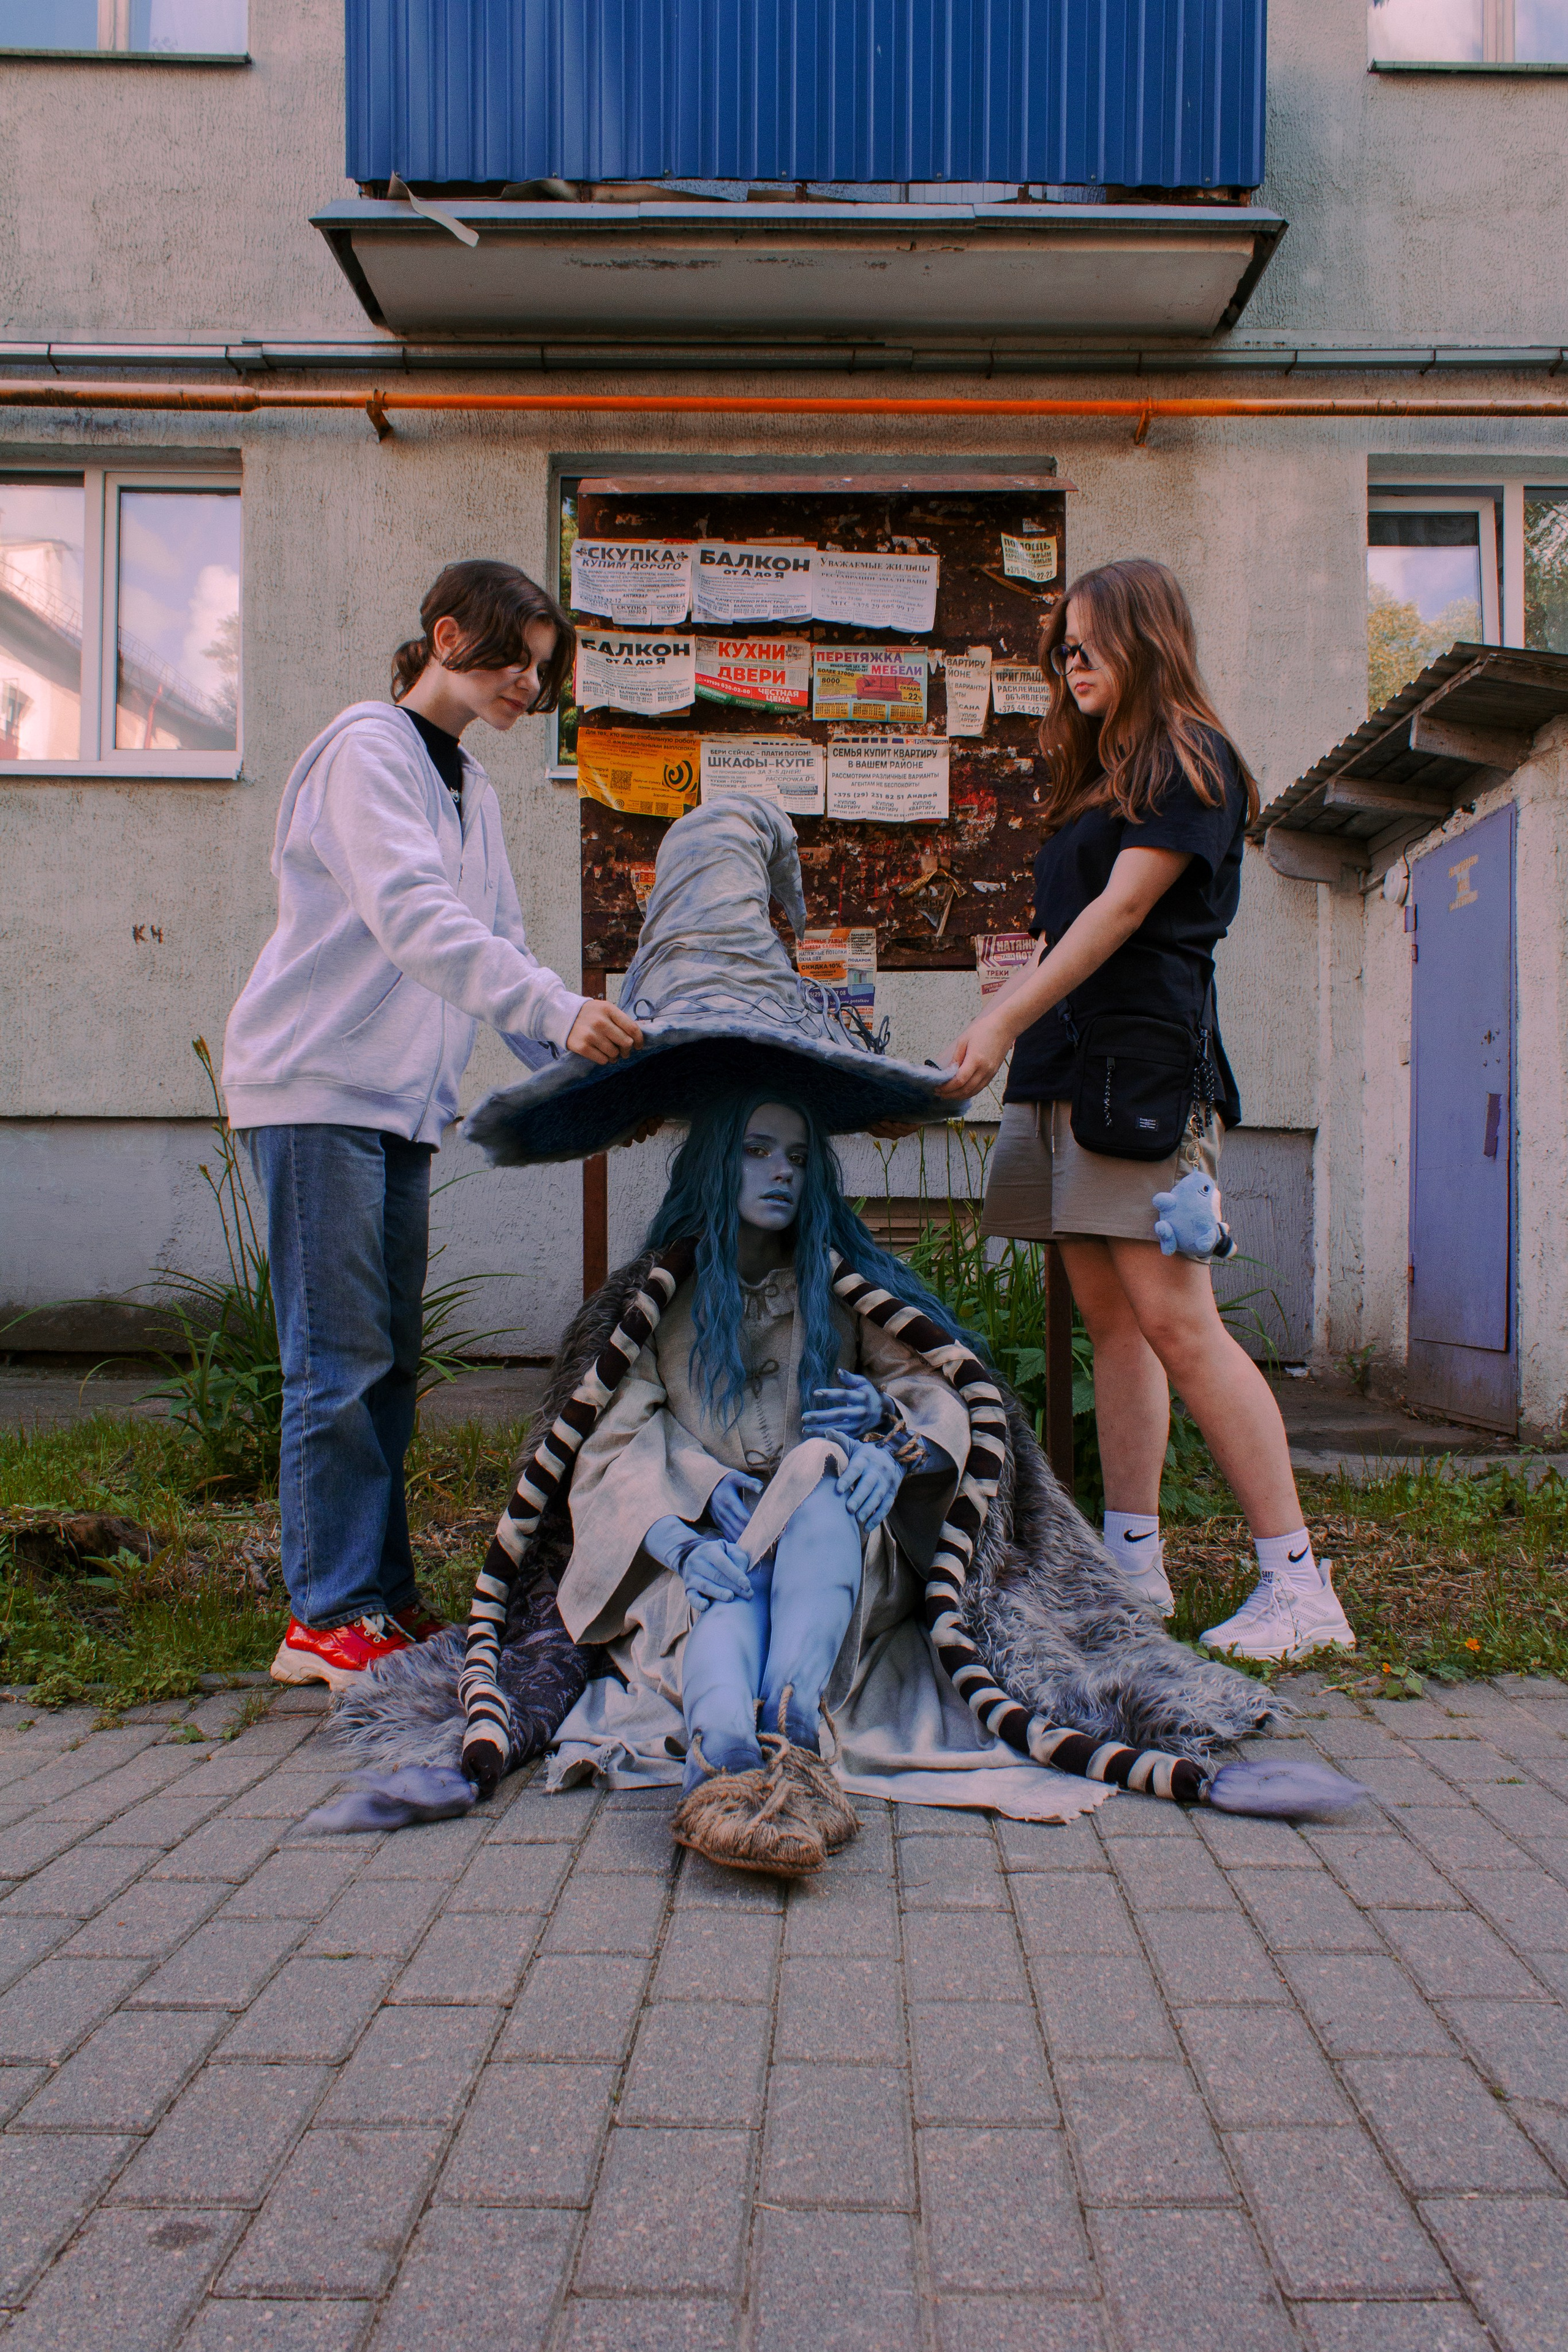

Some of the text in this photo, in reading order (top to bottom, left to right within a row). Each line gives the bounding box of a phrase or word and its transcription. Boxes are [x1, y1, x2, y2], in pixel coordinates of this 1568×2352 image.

[587, 547, 676, 563] СКУПКА
[699, 549, 810, 572] БАЛКОН
[582, 559, 682, 571] КУПИМ ДОРОГО
[886, 563, 930, 572] ЖИЛЬЦЫ
[581, 639, 690, 657] БАЛКОН
[718, 641, 786, 661] КУХНИ
[816, 651, 903, 663] ПЕРЕТЯЖКА
[717, 666, 786, 685] ДВЕРИ
[871, 665, 922, 676] МЕБЕЛИ
[721, 684, 751, 695] 630-02-80
[955, 682, 987, 692] ВАРИАНТЫ
[758, 688, 799, 698] ЧЕСТНАЯ
[766, 695, 791, 704] ЦЕНА
[612, 740, 662, 748] еженедельными
[637, 734, 673, 744] стабильную
[833, 748, 938, 758] СЕМЬЯ КУПИТ КВАРТИРУ
[707, 756, 815, 768] ШКАФЫ-КУПЕ
[889, 759, 924, 769] РАЙОНЕ
